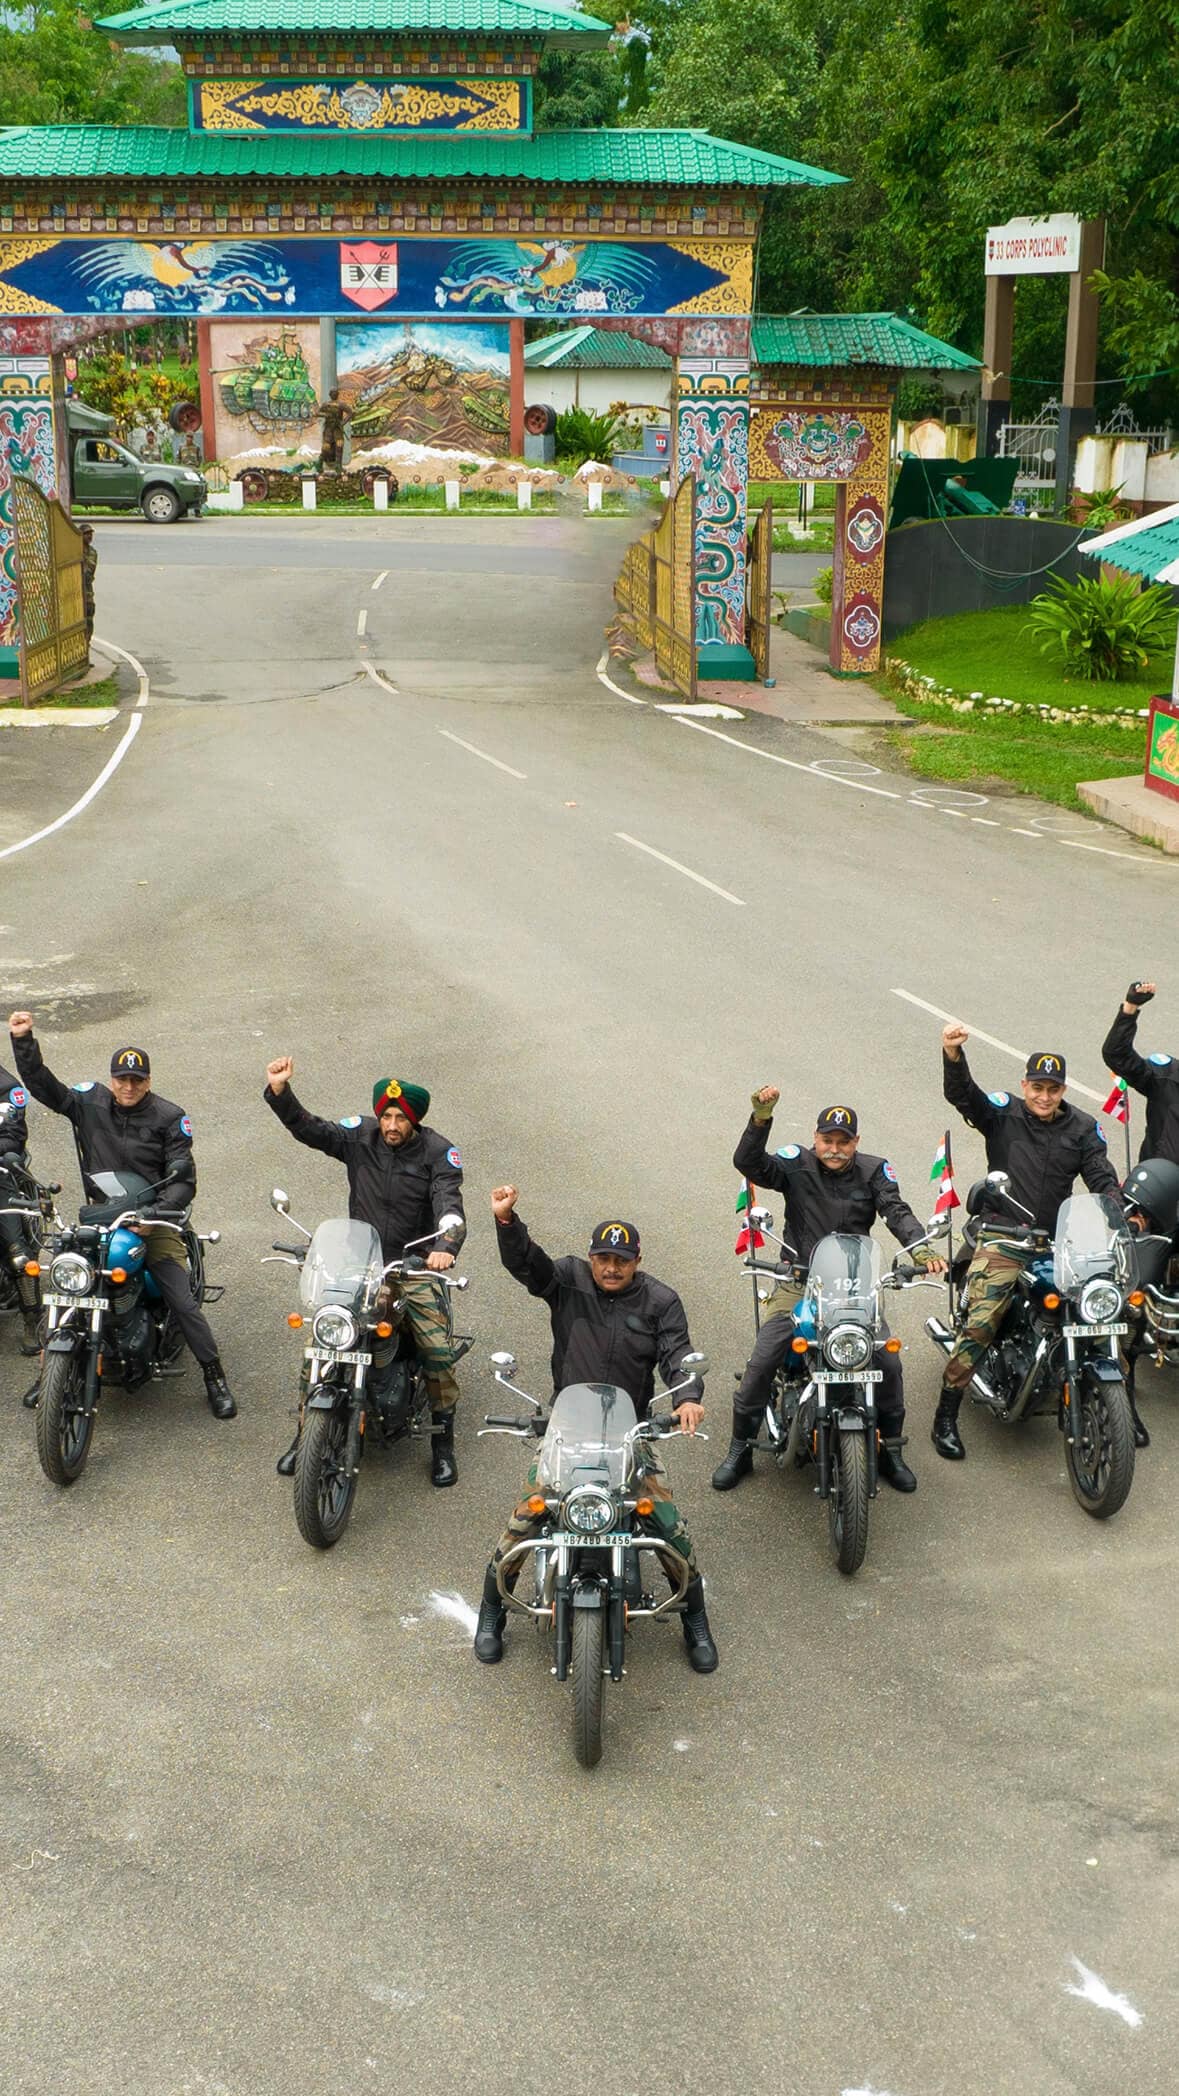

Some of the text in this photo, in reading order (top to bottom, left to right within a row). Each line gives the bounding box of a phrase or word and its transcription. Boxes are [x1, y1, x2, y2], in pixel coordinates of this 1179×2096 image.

[996, 235, 1067, 260] 33 CORPS POLYCLINIC
[833, 1278, 861, 1291] 192
[1073, 1326, 1082, 1335] WB
[822, 1373, 833, 1382] WB
[606, 1535, 630, 1545] 8456
